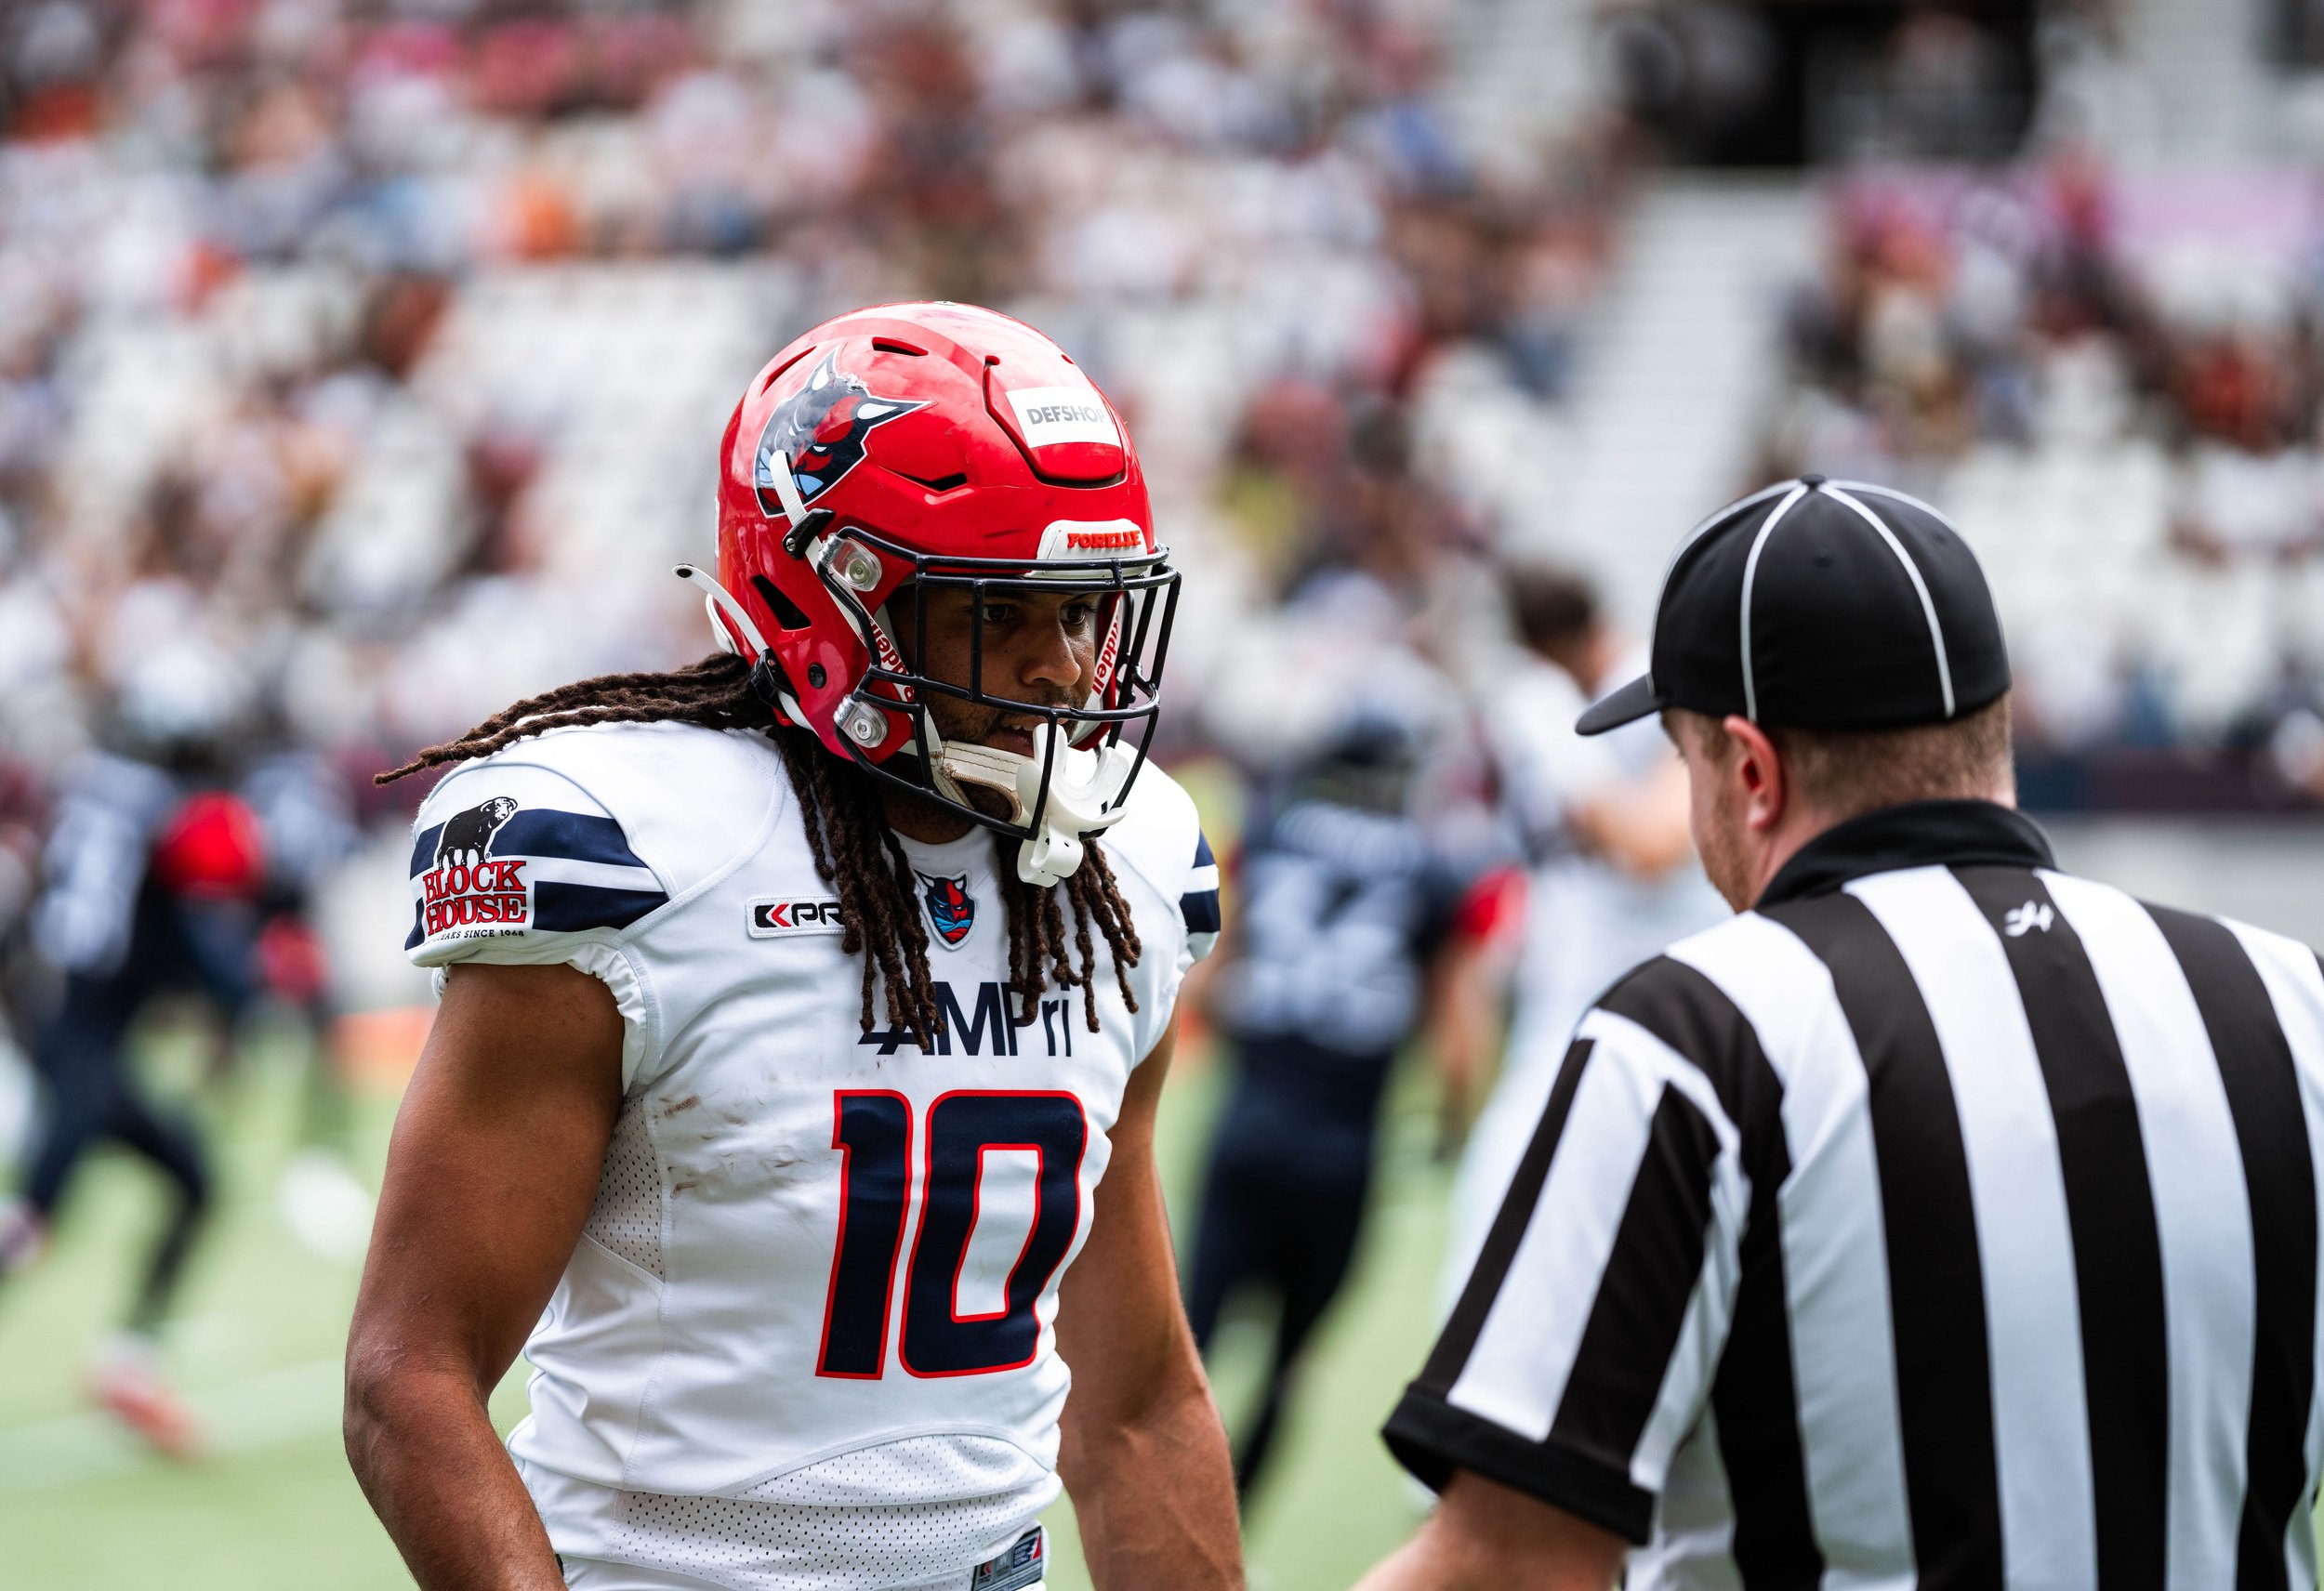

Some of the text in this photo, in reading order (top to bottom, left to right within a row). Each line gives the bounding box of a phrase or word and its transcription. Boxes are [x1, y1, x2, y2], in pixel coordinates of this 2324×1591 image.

[1066, 530, 1142, 548] FORELLE
[1091, 614, 1119, 696] iddell
[423, 861, 526, 905] BLOCK
[426, 894, 526, 936] HOUSE
[465, 930, 495, 939] SINCE
[754, 902, 847, 927] KPR
[815, 1089, 1088, 1380] 10
